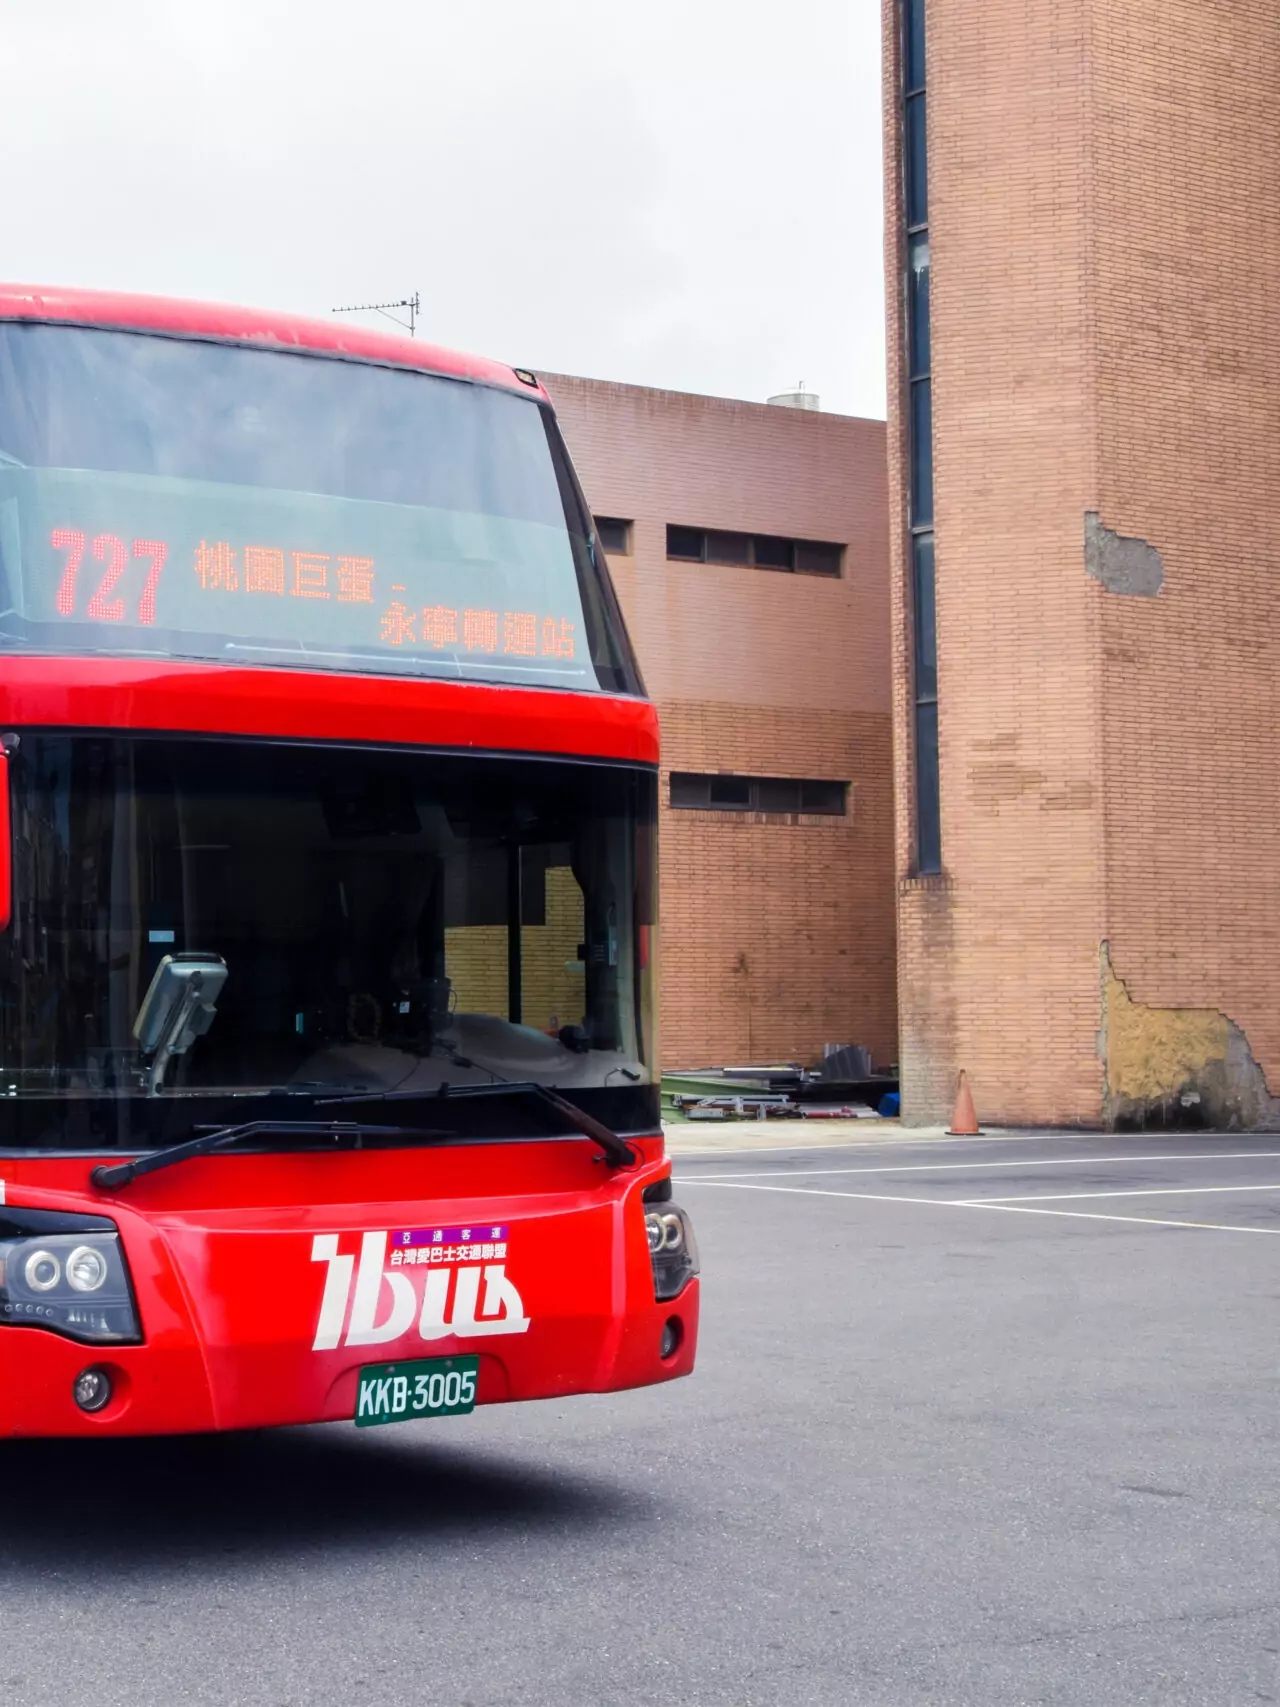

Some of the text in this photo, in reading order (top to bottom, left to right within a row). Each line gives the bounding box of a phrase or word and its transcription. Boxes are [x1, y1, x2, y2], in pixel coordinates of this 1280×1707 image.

[51, 529, 167, 625] 727
[194, 540, 375, 604] 桃園巨蛋
[379, 600, 576, 659] 永寧轉運站
[390, 1243, 507, 1266] 台灣愛巴士交通聯盟
